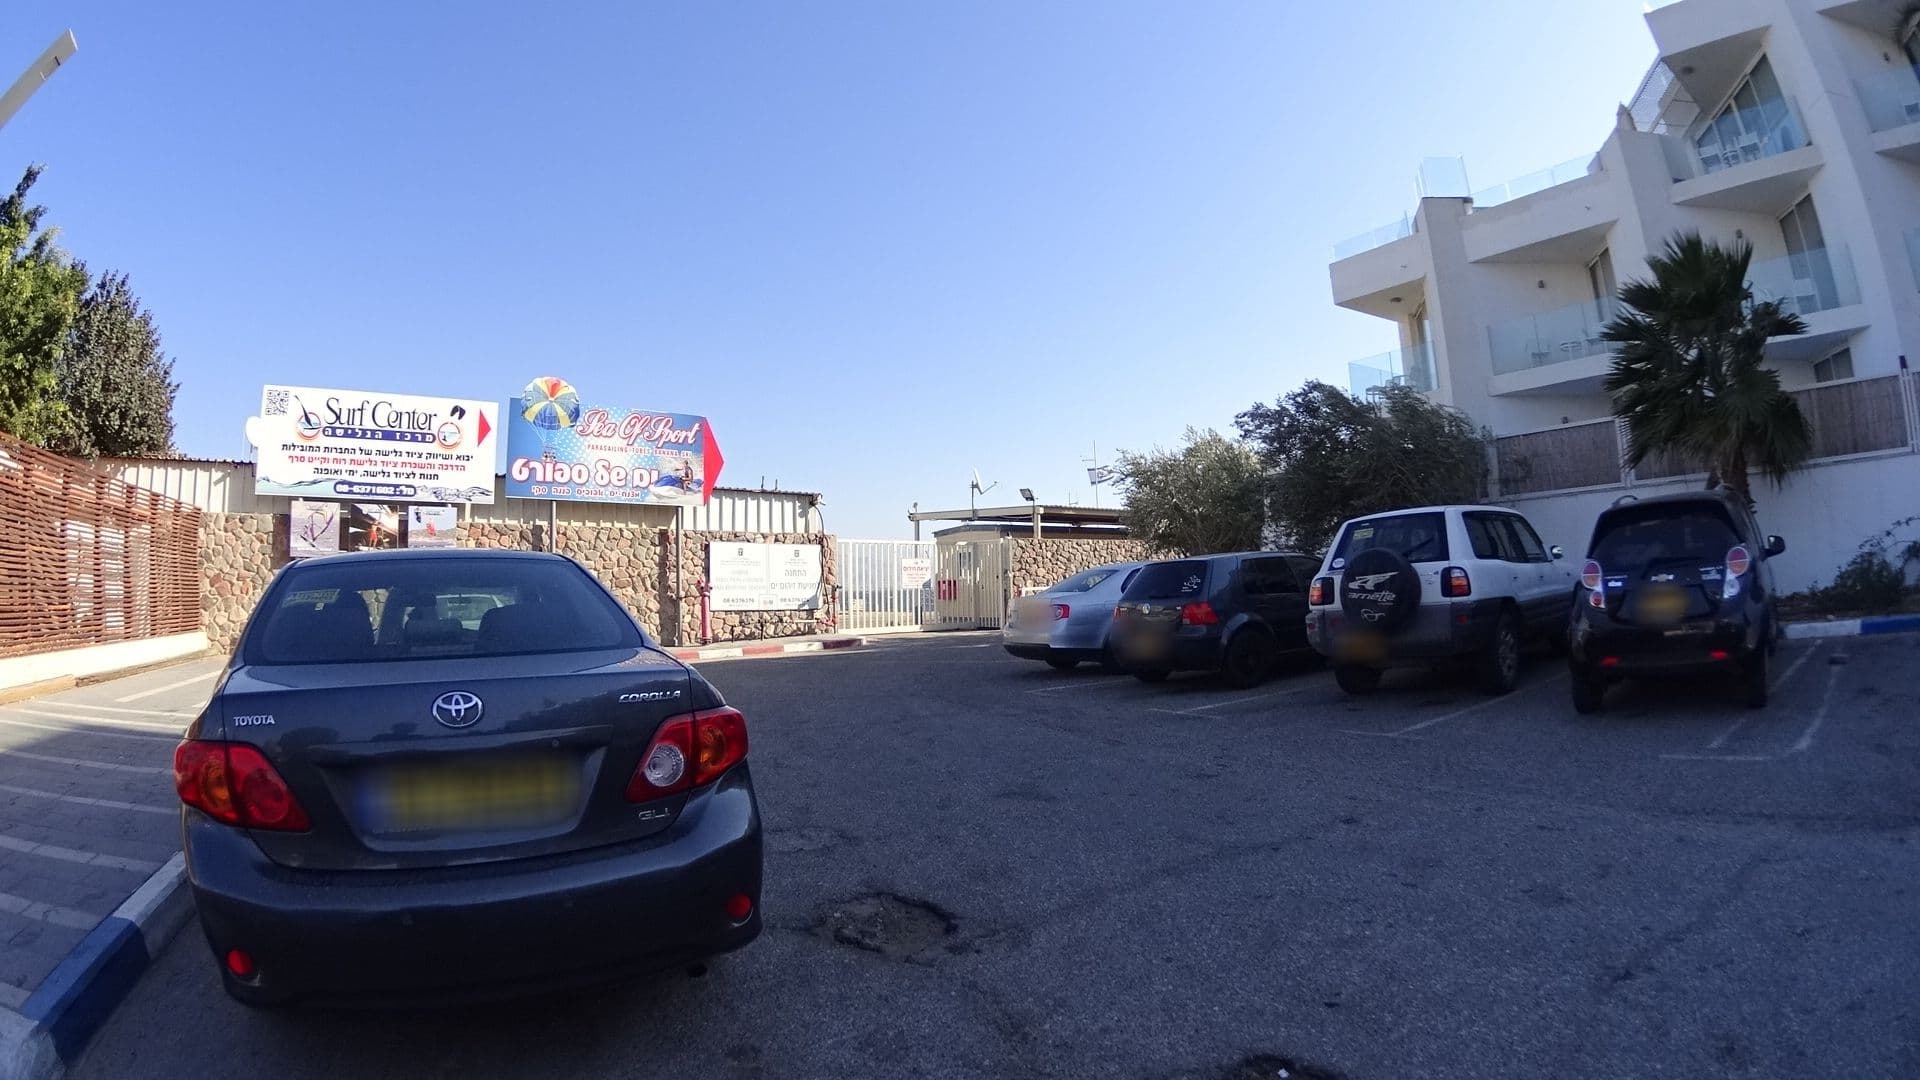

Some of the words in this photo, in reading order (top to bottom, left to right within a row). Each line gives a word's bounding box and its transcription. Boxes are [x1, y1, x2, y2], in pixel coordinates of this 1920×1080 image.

[324, 397, 369, 426] Surf
[372, 400, 437, 431] Center
[324, 427, 383, 440] הגלישה
[576, 409, 617, 438] Sea
[618, 412, 651, 446] Of
[643, 416, 702, 449] Sport
[395, 432, 433, 443] מרכז
[281, 443, 320, 453] המובילות
[323, 446, 356, 455] החברות
[359, 447, 373, 456] של
[375, 449, 403, 457] גלישה
[405, 450, 423, 459] ציוד
[425, 452, 453, 461] ושיווק
[455, 453, 474, 462] יבוא
[288, 455, 306, 464] סרף
[307, 456, 330, 465] וקייט
[332, 457, 346, 465] רוח
[349, 458, 378, 467] גלישת
[380, 460, 398, 468] ציוד
[400, 461, 435, 470] והשכרת
[438, 463, 466, 472] הדרכה
[313, 467, 343, 476] ואופנה
[393, 470, 417, 480] לציוד
[511, 456, 590, 485] ספורט
[594, 458, 627, 488] של
[418, 473, 439, 481] חנות
[1347, 590, 1396, 602] arnette
[619, 690, 681, 703] COROLLA
[233, 715, 275, 726] TOYOTA
